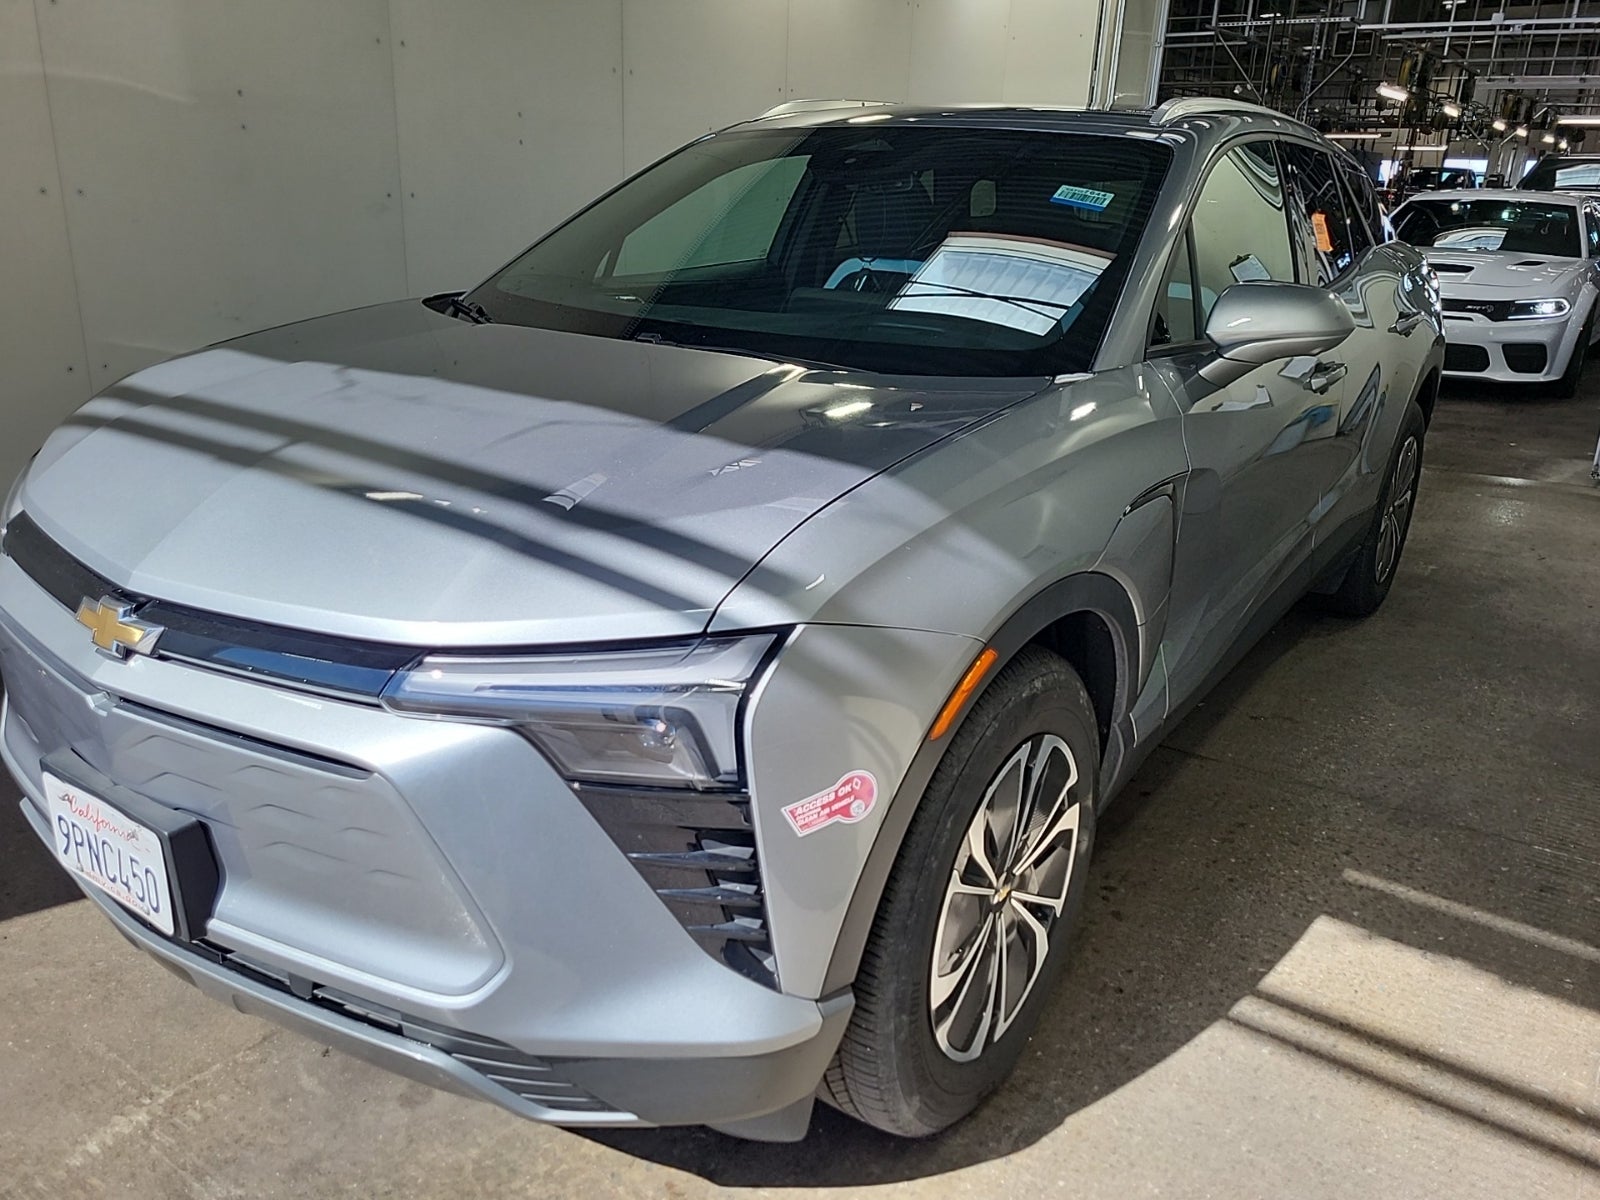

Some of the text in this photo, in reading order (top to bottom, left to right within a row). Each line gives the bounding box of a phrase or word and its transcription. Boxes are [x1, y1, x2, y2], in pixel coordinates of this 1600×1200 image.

[68, 793, 139, 842] California
[795, 790, 836, 817] ACCESS
[837, 783, 852, 798] OK
[57, 814, 161, 914] 9PNC450
